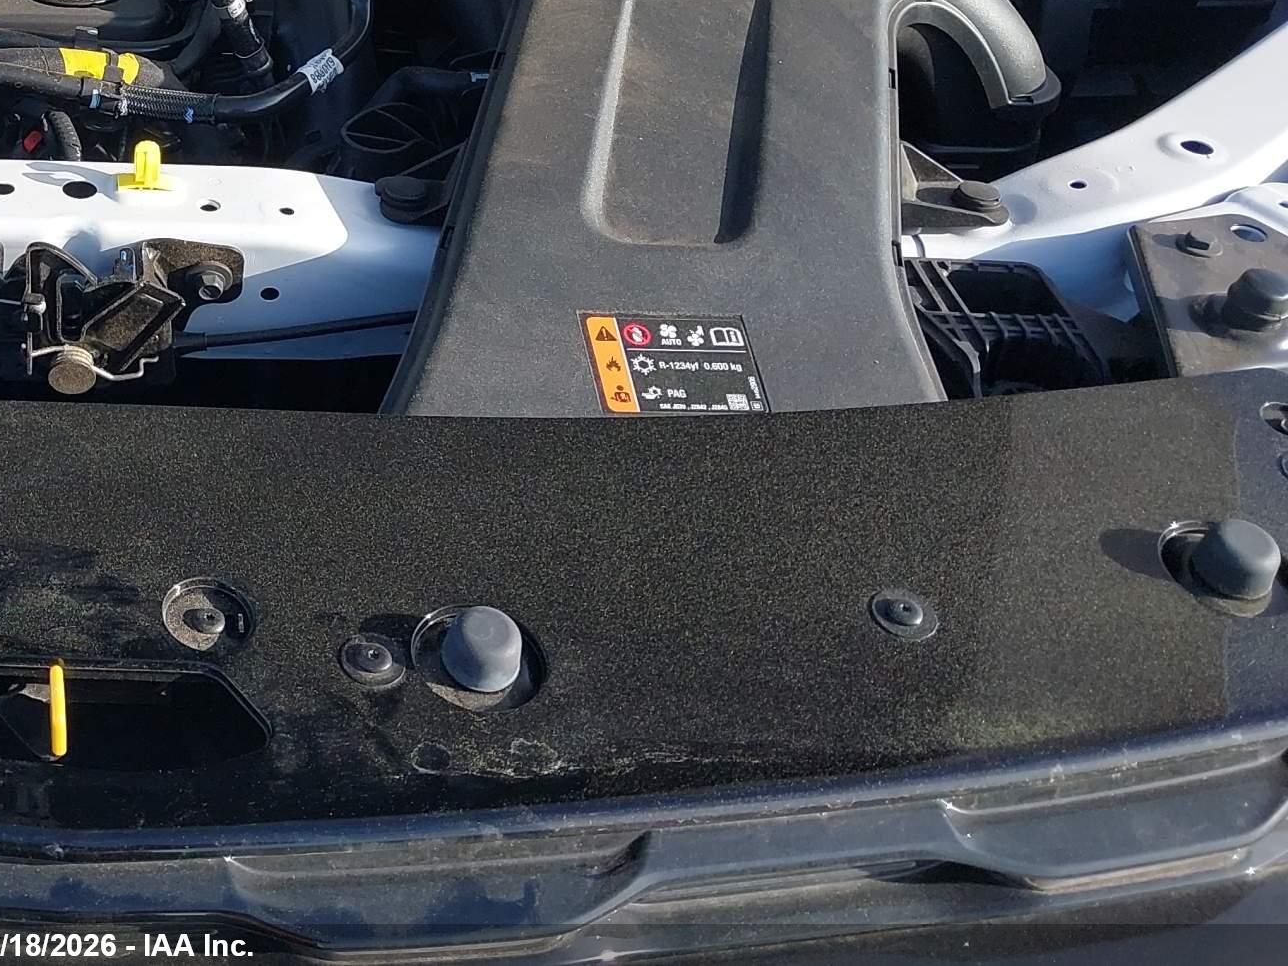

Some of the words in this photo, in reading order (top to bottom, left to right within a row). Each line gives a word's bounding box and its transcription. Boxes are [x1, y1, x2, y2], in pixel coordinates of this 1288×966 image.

[661, 338, 682, 346] AUTO
[658, 361, 699, 372] R-1234yf
[730, 362, 743, 372] kg
[667, 389, 687, 399] PAG
